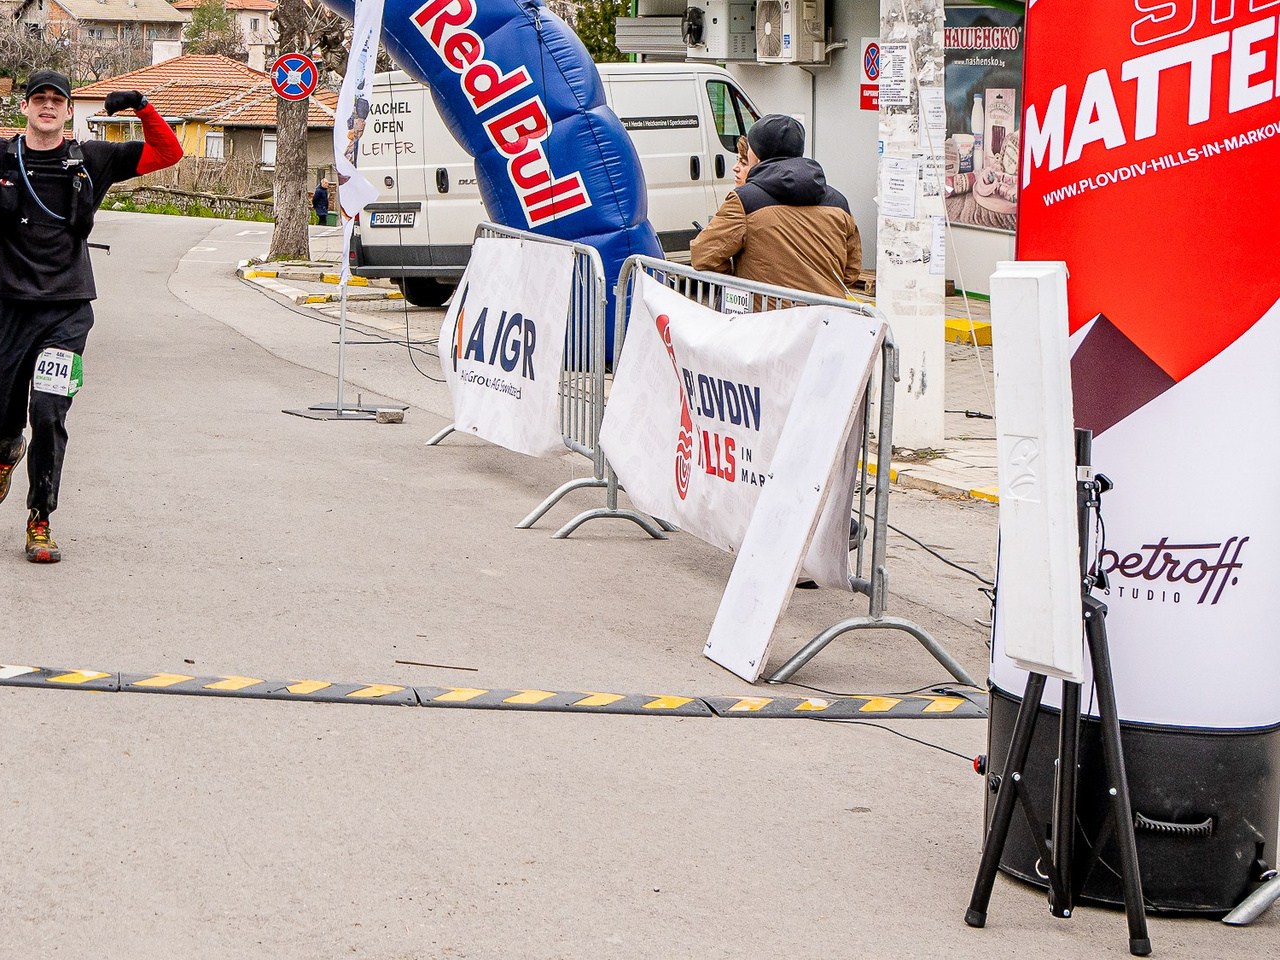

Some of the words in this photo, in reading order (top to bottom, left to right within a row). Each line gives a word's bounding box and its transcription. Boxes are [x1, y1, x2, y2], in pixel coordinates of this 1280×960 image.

[953, 55, 1006, 68] www.nashensko.bg
[1022, 14, 1280, 191] MATTE
[373, 119, 404, 133] ÖFEN
[362, 141, 417, 156] LEITER
[482, 95, 592, 229] Bull
[385, 214, 401, 224] 0271
[403, 213, 413, 224] ME
[38, 361, 68, 378] 4214
[741, 446, 752, 463] IN
[1104, 586, 1181, 604] STUDIO
